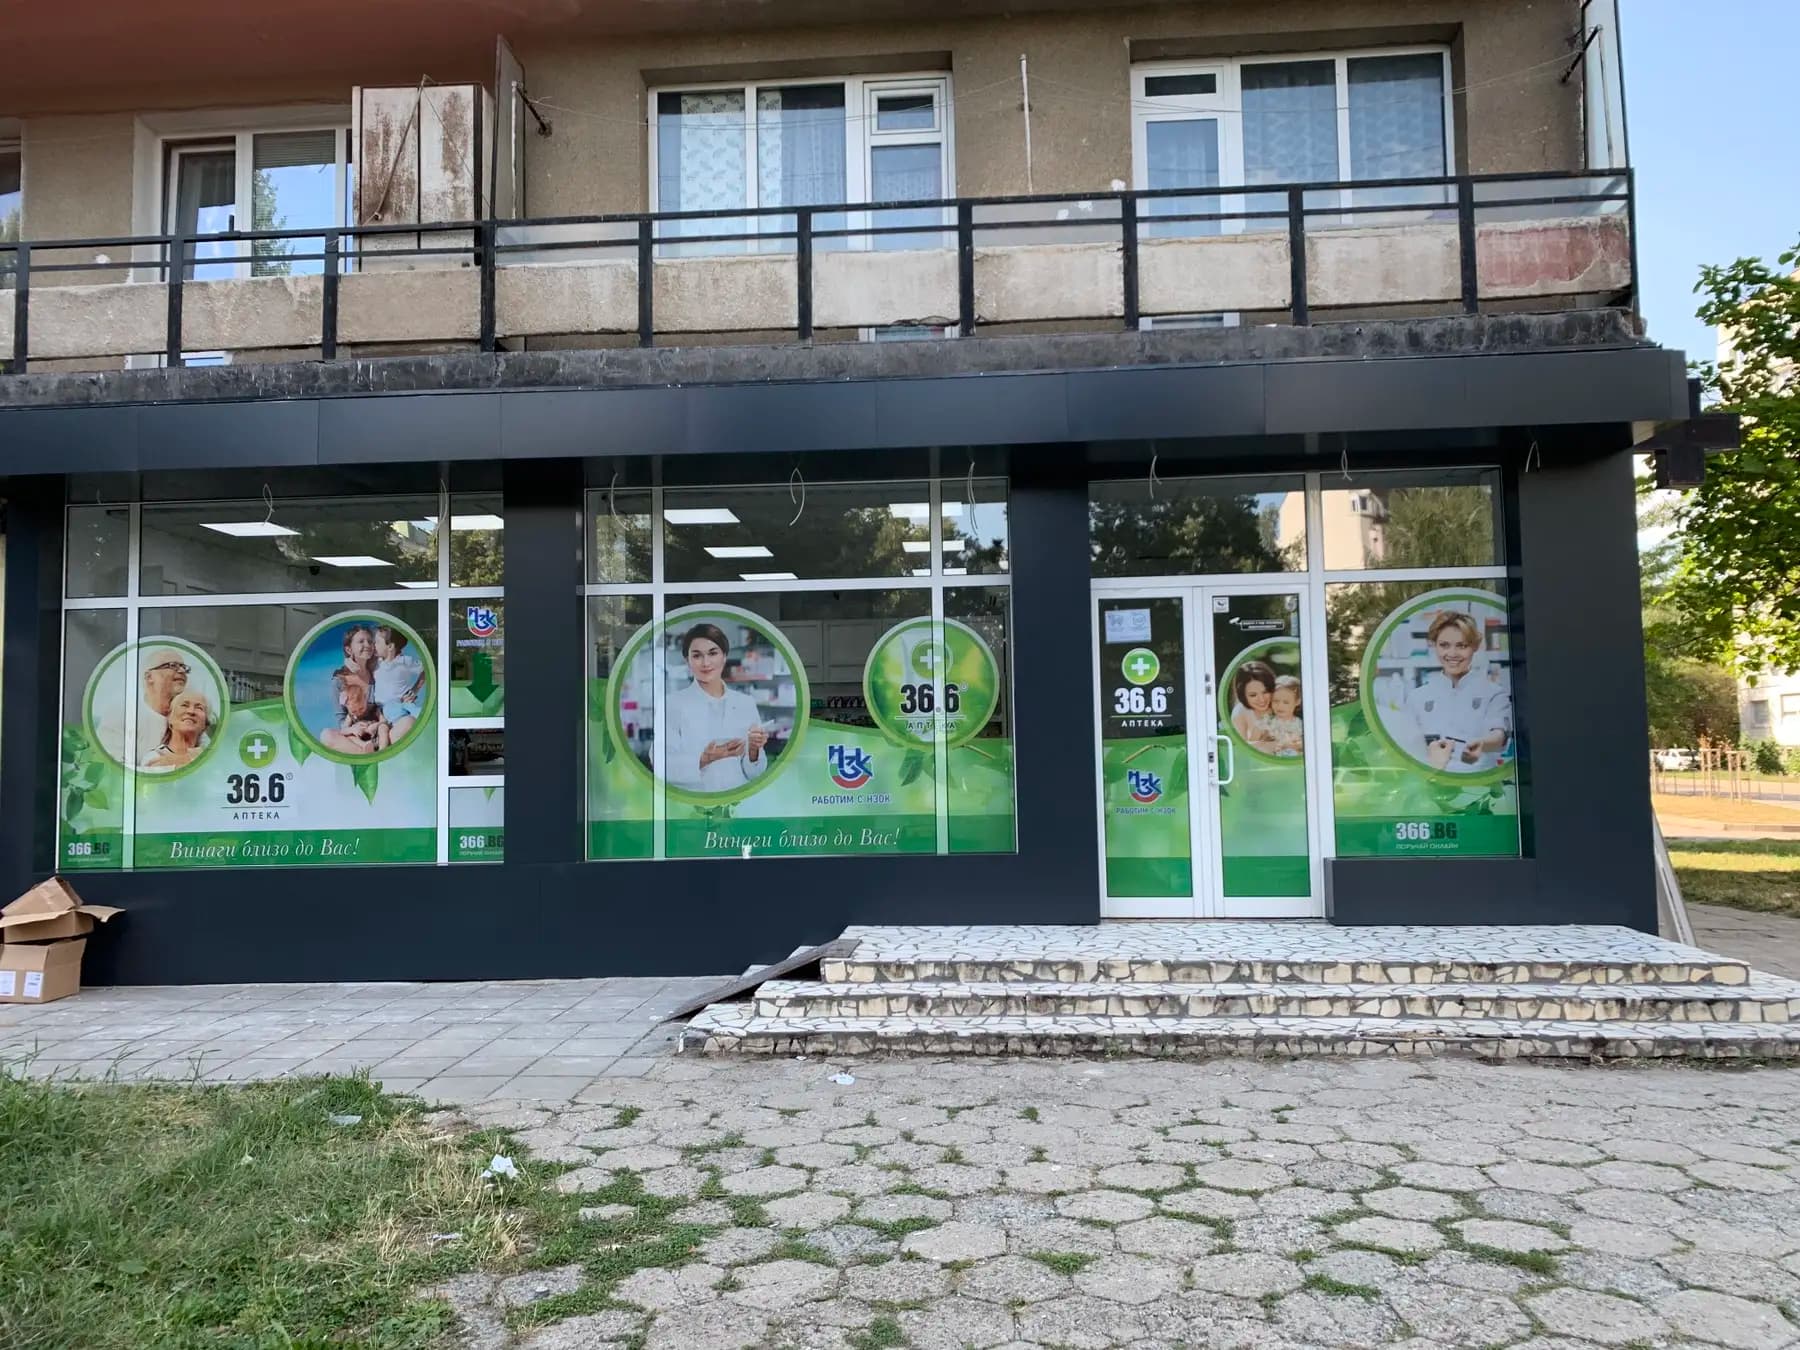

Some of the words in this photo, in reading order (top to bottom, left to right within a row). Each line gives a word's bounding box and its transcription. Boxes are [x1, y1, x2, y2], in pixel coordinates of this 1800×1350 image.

[811, 795, 854, 805] РАБОТИМ
[866, 794, 890, 804] НЗОК
[233, 811, 280, 820] АПТЕКА
[704, 831, 772, 850] Винаги
[779, 829, 828, 848] близо
[833, 828, 853, 847] до
[859, 827, 900, 847] Вас!
[1396, 822, 1457, 840] 366.BG
[68, 842, 110, 856] 366.BG
[170, 841, 236, 860] Винаги
[242, 839, 289, 858] близо
[295, 837, 314, 857] до
[320, 837, 360, 856] Вас!
